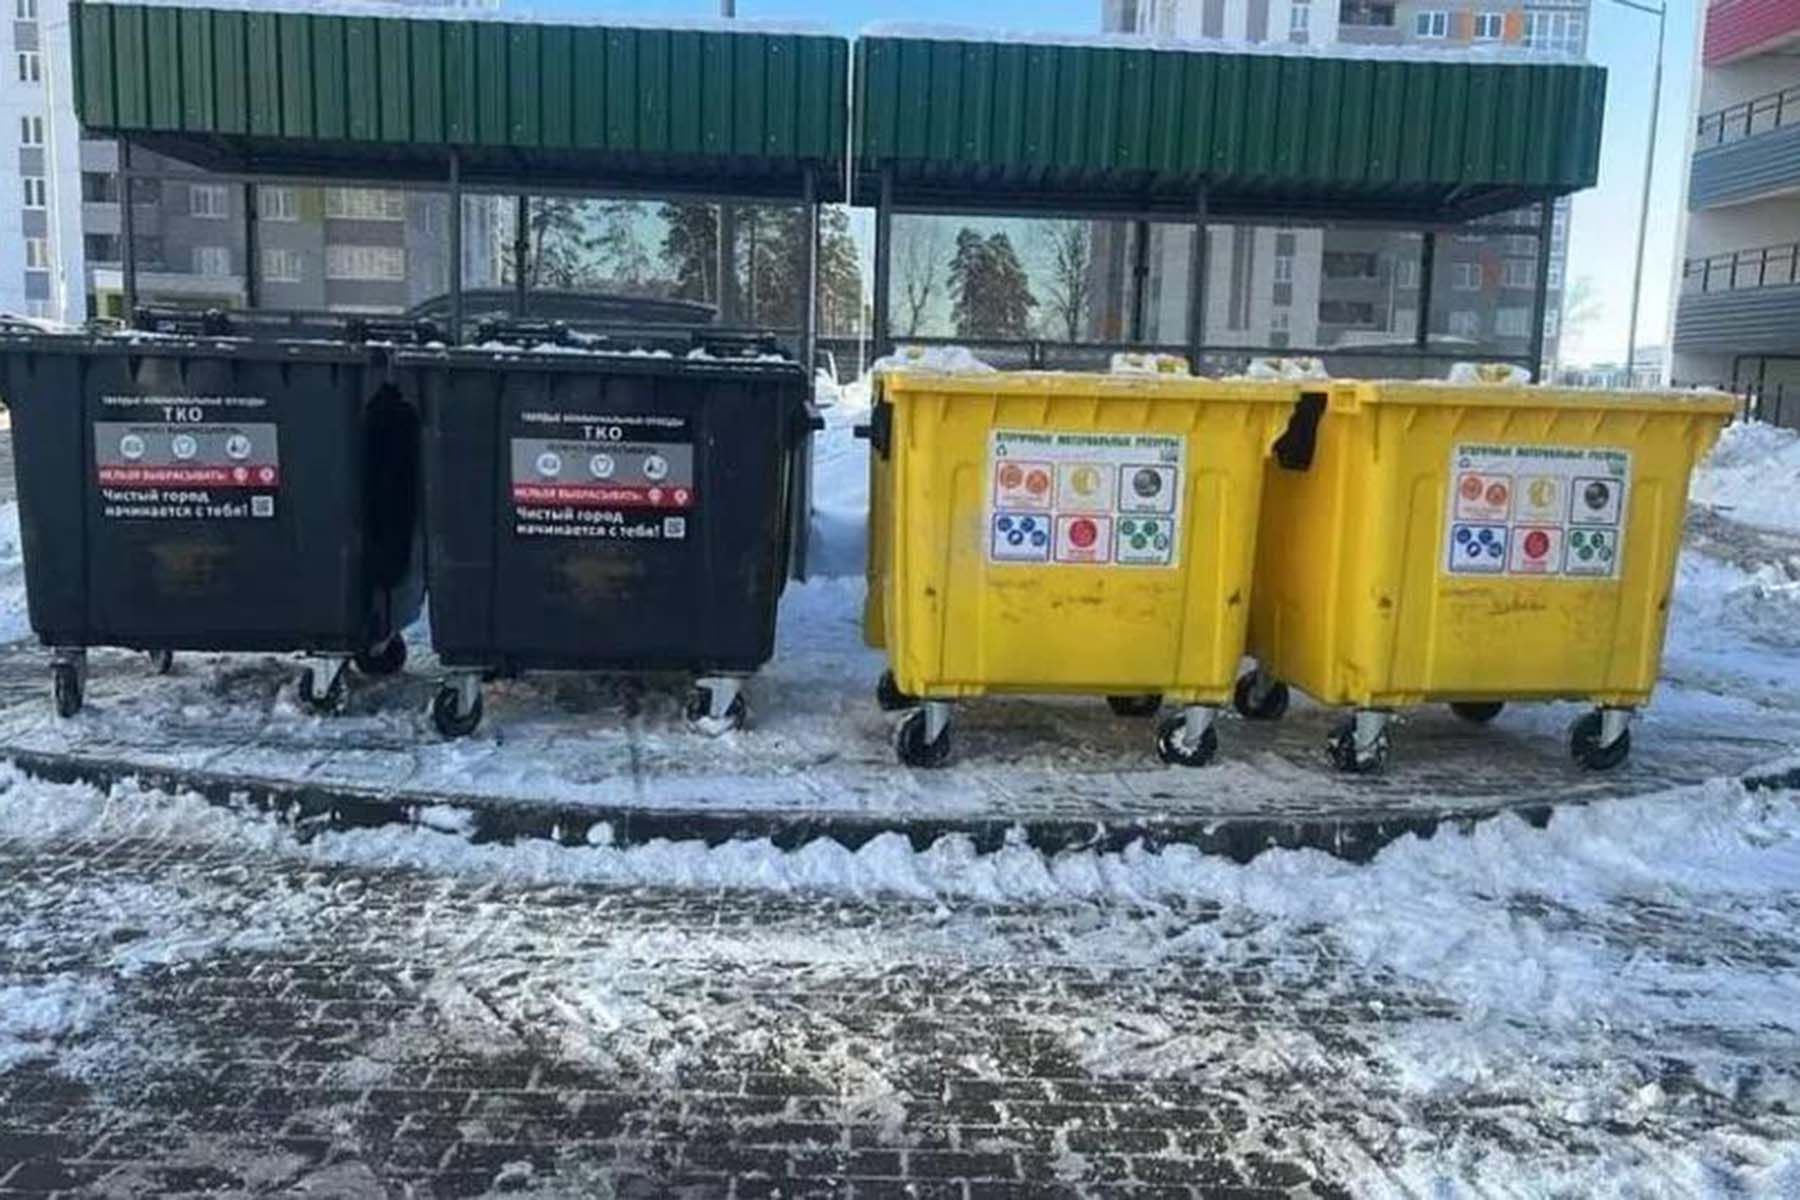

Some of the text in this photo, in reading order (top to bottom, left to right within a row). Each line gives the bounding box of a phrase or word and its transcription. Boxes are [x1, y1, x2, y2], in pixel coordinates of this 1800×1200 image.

[163, 407, 203, 422] ТКО
[583, 426, 623, 440] ТКО
[102, 488, 210, 503] Чистый город
[105, 503, 248, 517] начинается с тебя!
[516, 507, 624, 524] Чистый город
[516, 525, 660, 538] начинается с тебя!
